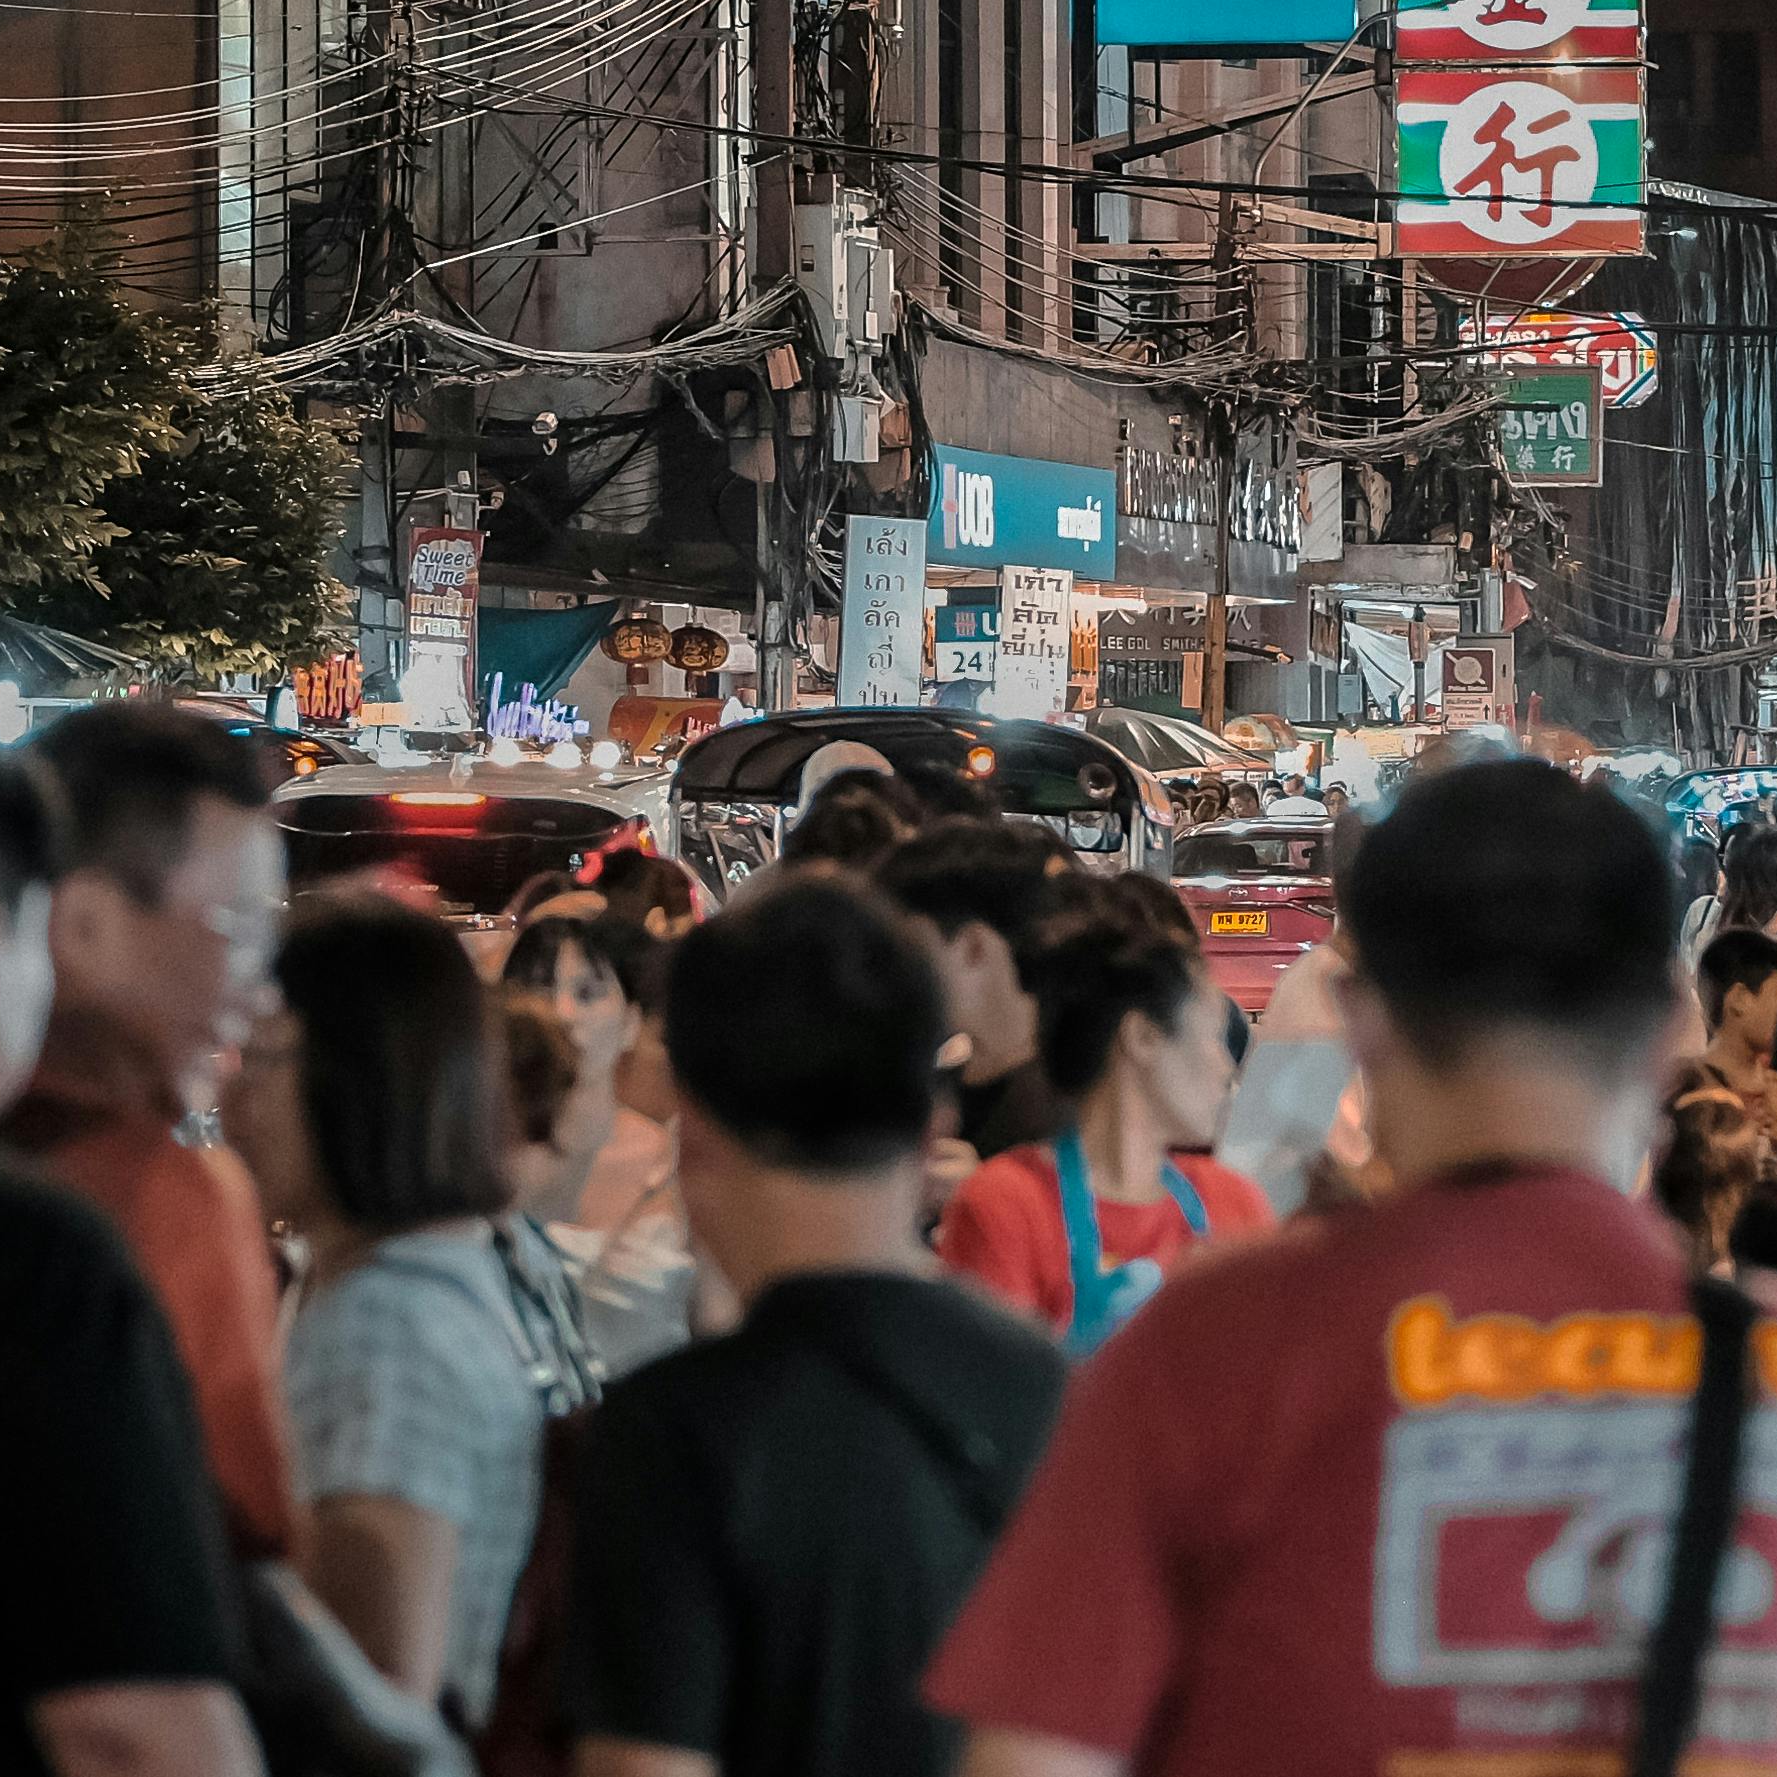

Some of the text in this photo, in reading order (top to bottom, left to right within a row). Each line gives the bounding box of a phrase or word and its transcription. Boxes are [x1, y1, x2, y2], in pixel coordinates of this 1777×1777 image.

[958, 470, 995, 548] UOB
[418, 545, 475, 568] Sweet
[1100, 635, 1123, 650] LEE
[952, 651, 983, 673] 24
